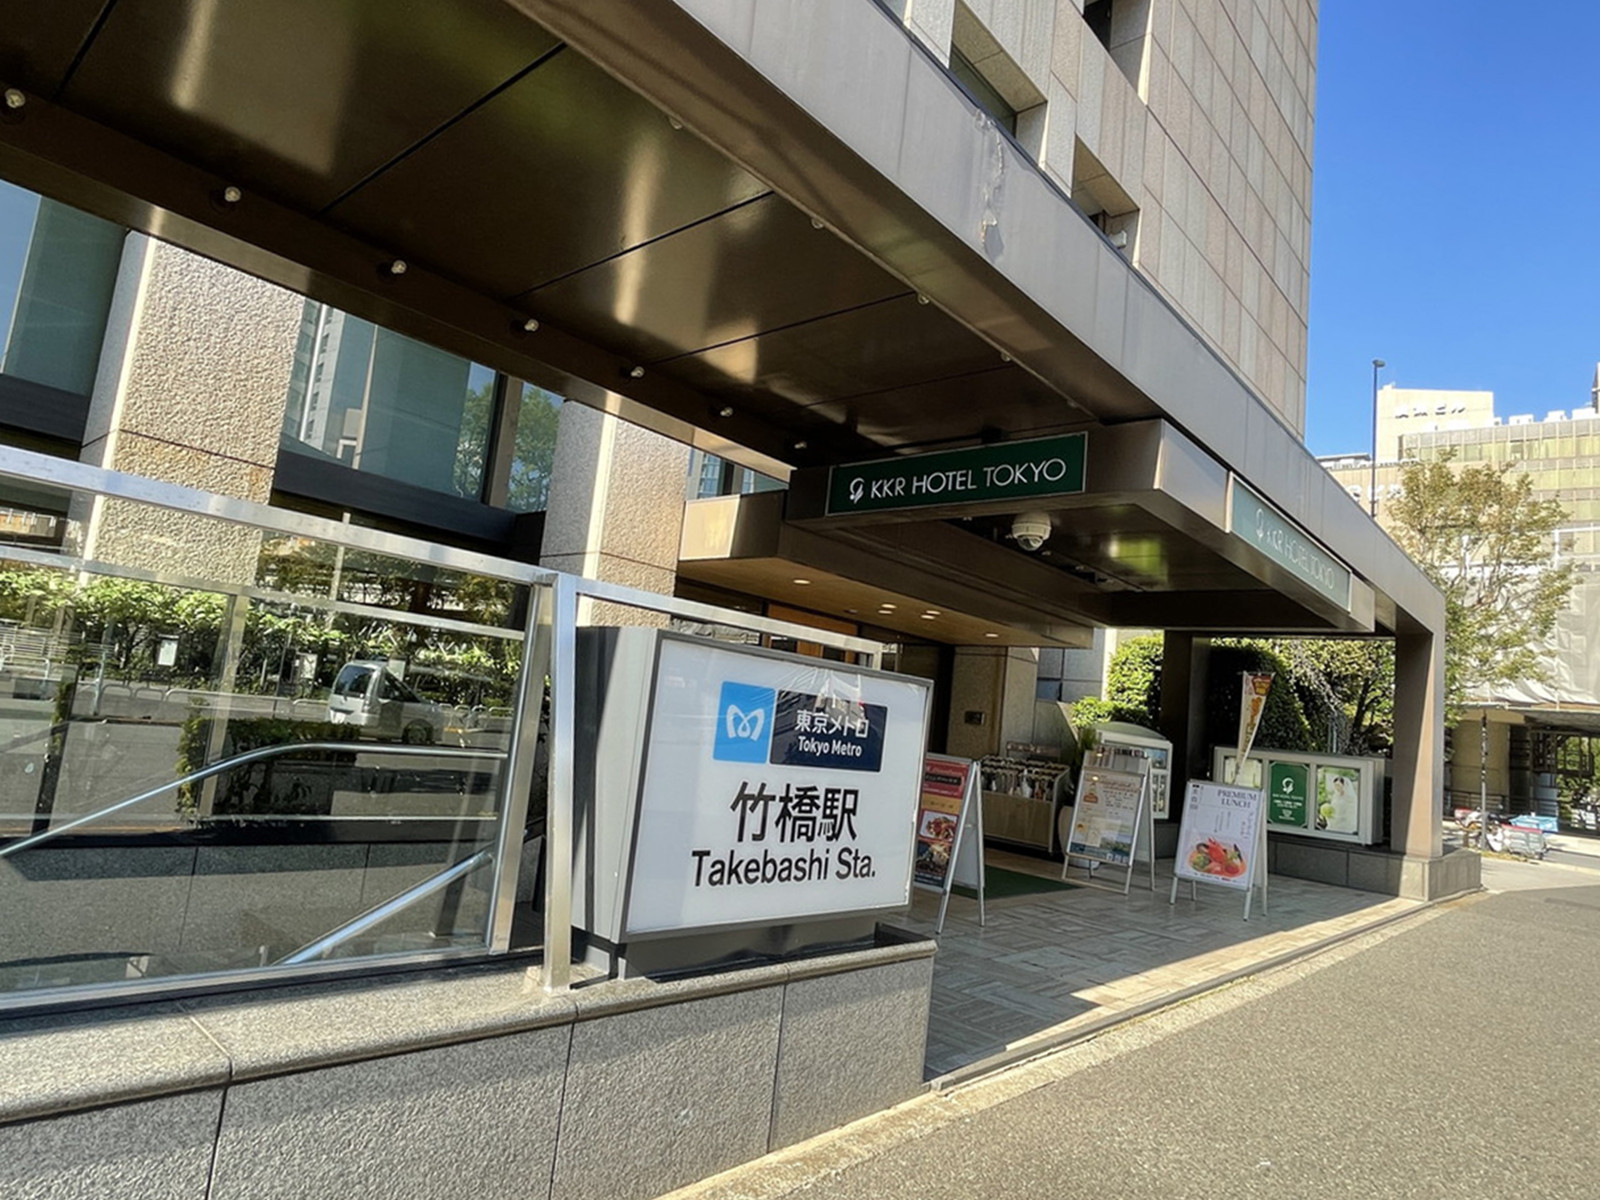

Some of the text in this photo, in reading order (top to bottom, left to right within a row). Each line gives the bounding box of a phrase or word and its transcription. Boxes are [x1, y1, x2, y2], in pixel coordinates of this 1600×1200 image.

[870, 458, 1066, 499] KKR HOTEL TOKYO
[794, 709, 869, 738] 東京メトロ
[798, 735, 863, 757] Tokyo Metro
[1217, 789, 1257, 801] PREMIUM
[1221, 797, 1251, 809] LUNCH
[730, 781, 859, 843] 竹橋駅
[691, 847, 830, 887] Takebashi
[835, 846, 876, 880] Sta.
